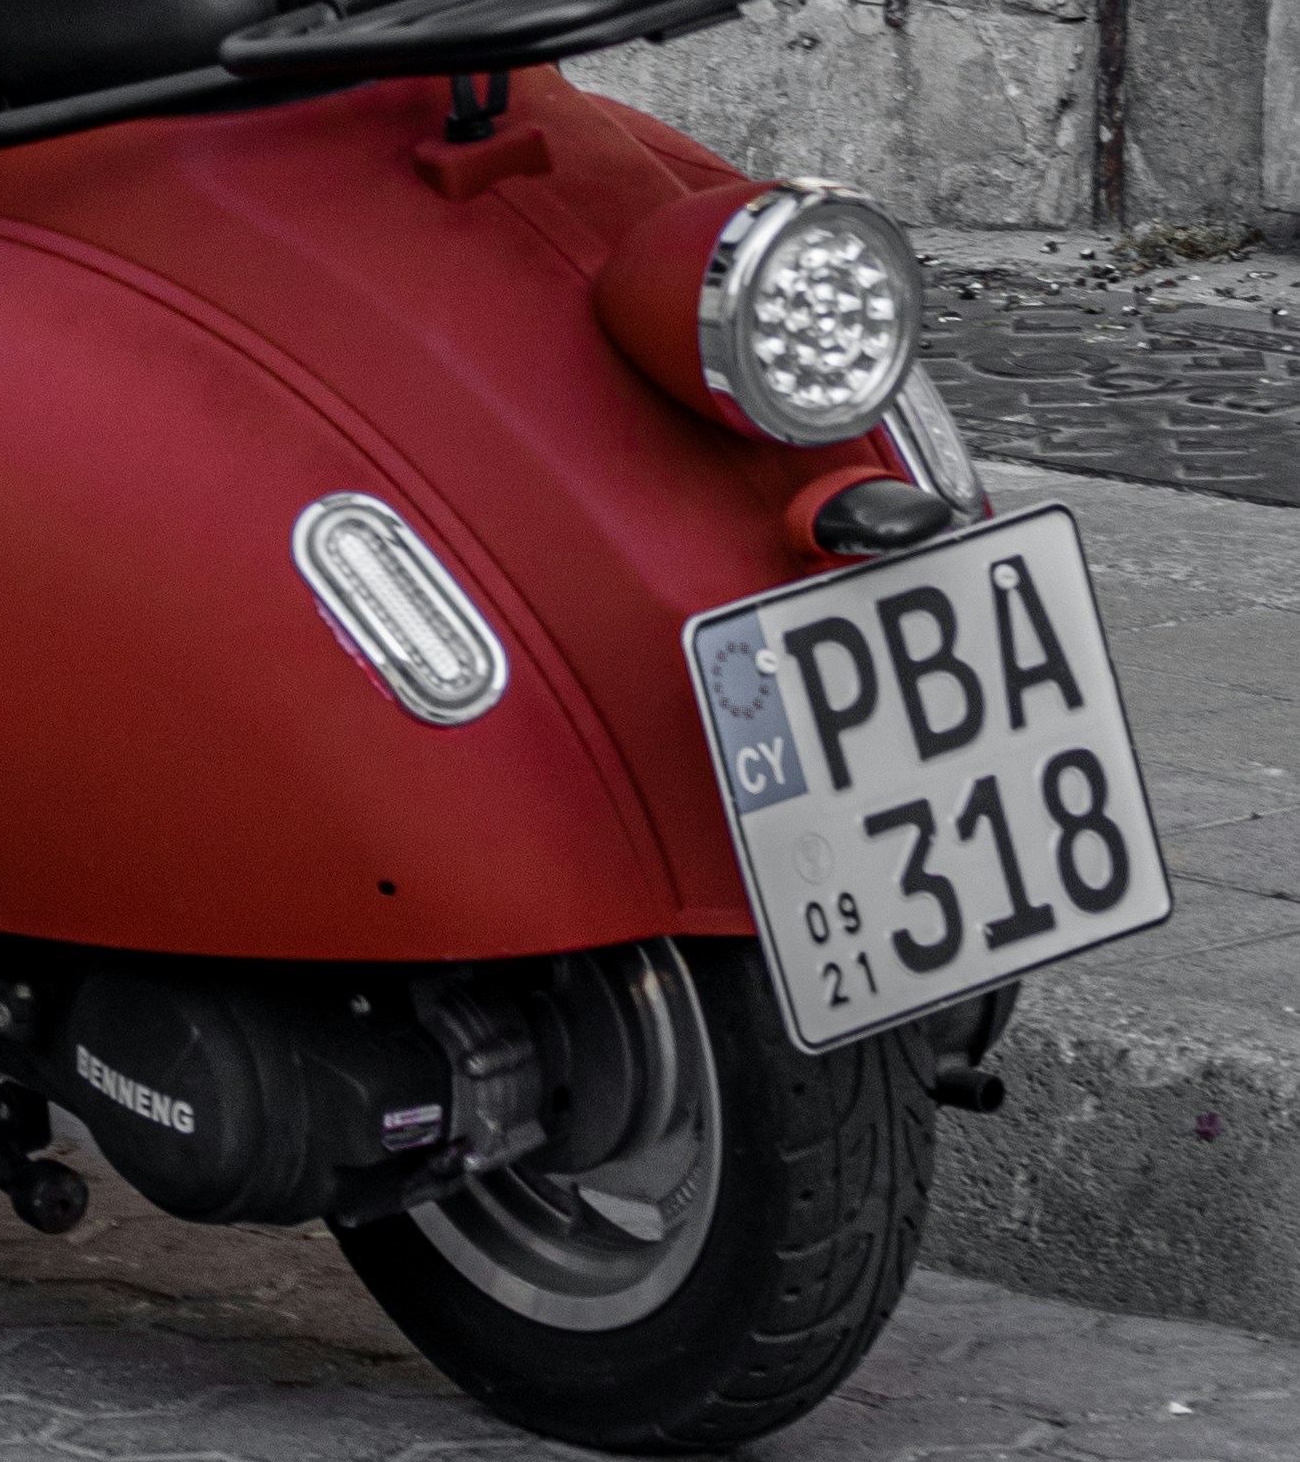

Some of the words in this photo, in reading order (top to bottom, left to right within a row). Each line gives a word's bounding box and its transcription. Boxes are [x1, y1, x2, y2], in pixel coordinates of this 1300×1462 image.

[782, 554, 1085, 792] PBA
[735, 736, 786, 795] CY
[863, 748, 1131, 975] 318
[804, 891, 862, 945] 09
[821, 950, 878, 1007] 21
[75, 1043, 195, 1135] BENNENG
